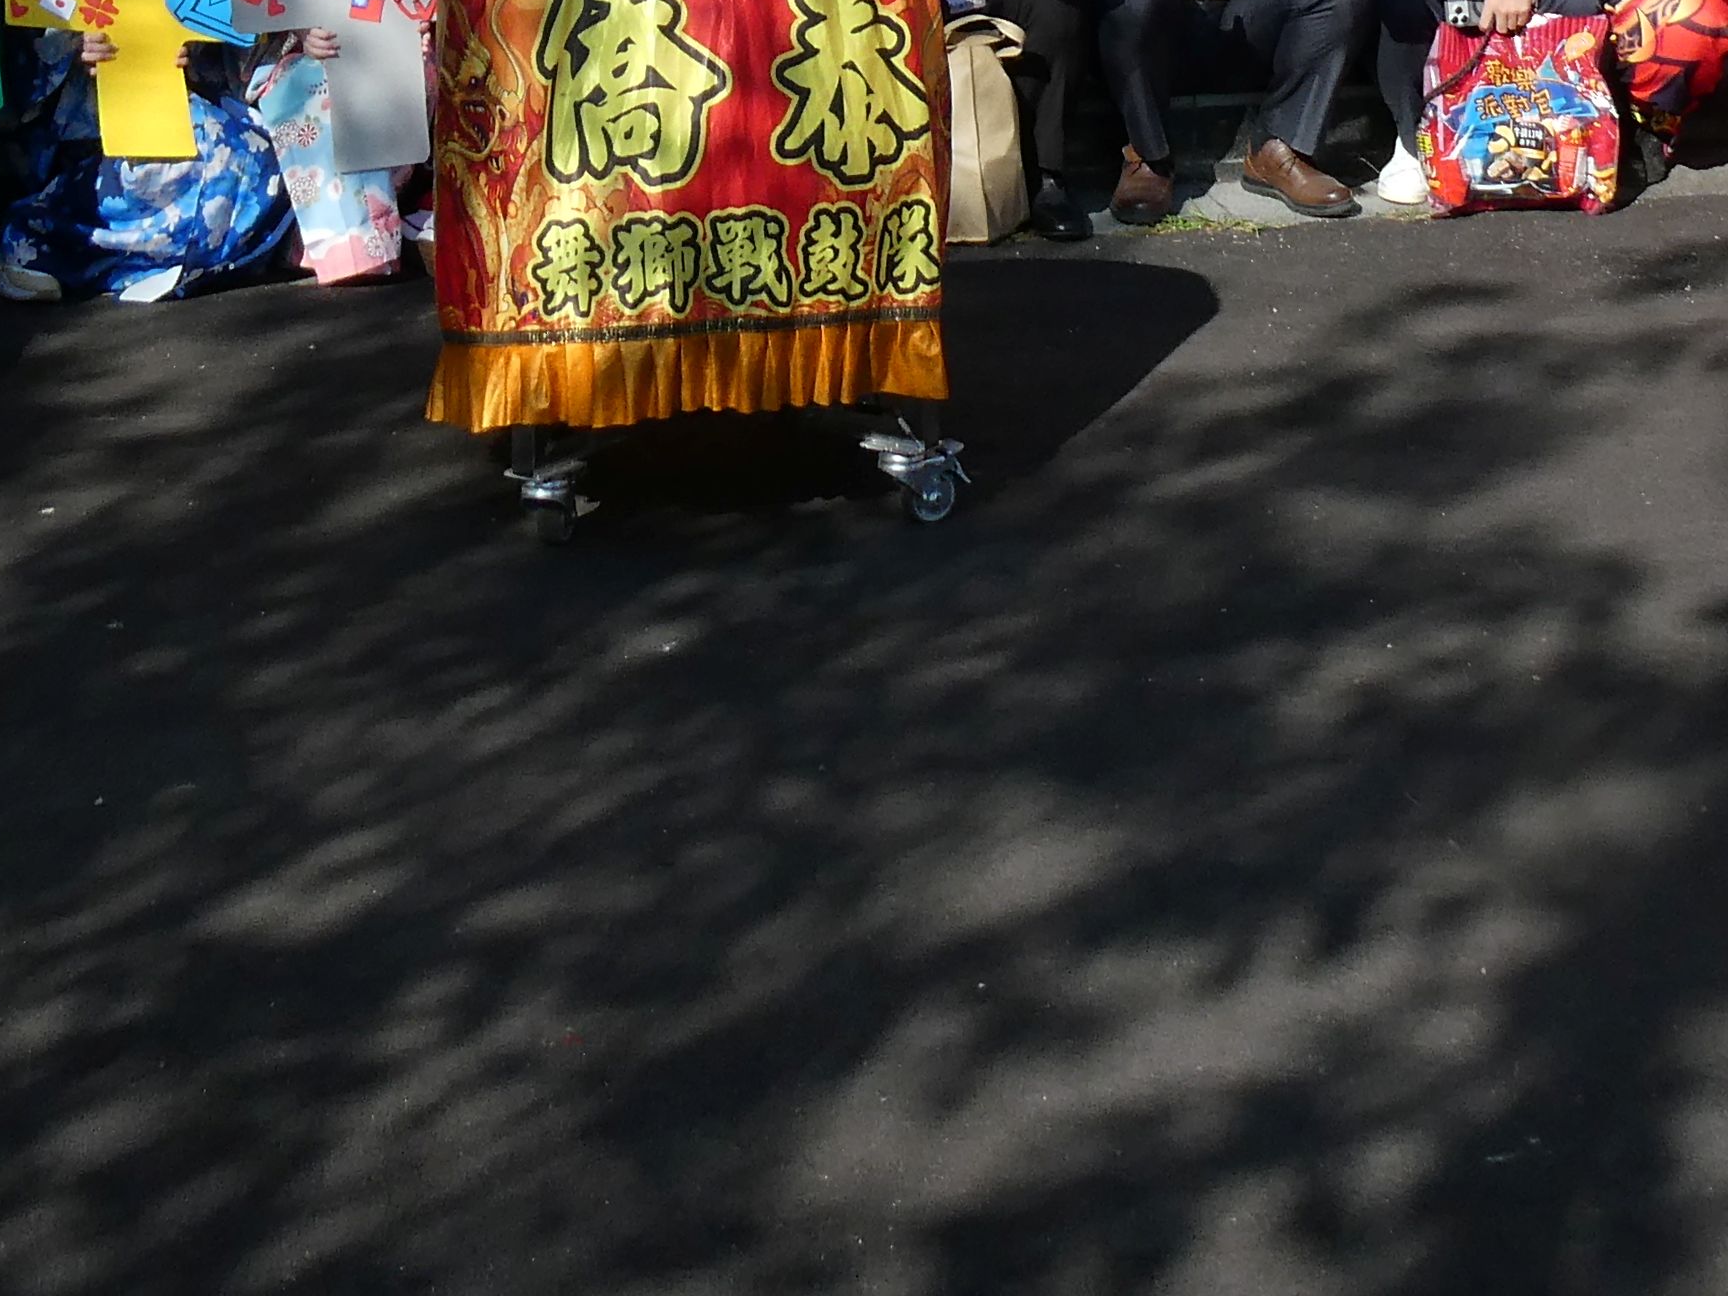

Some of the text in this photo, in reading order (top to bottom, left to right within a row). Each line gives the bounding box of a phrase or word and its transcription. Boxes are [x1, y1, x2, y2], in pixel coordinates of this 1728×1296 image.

[530, 199, 941, 317] 舞獅戰鼓隊
